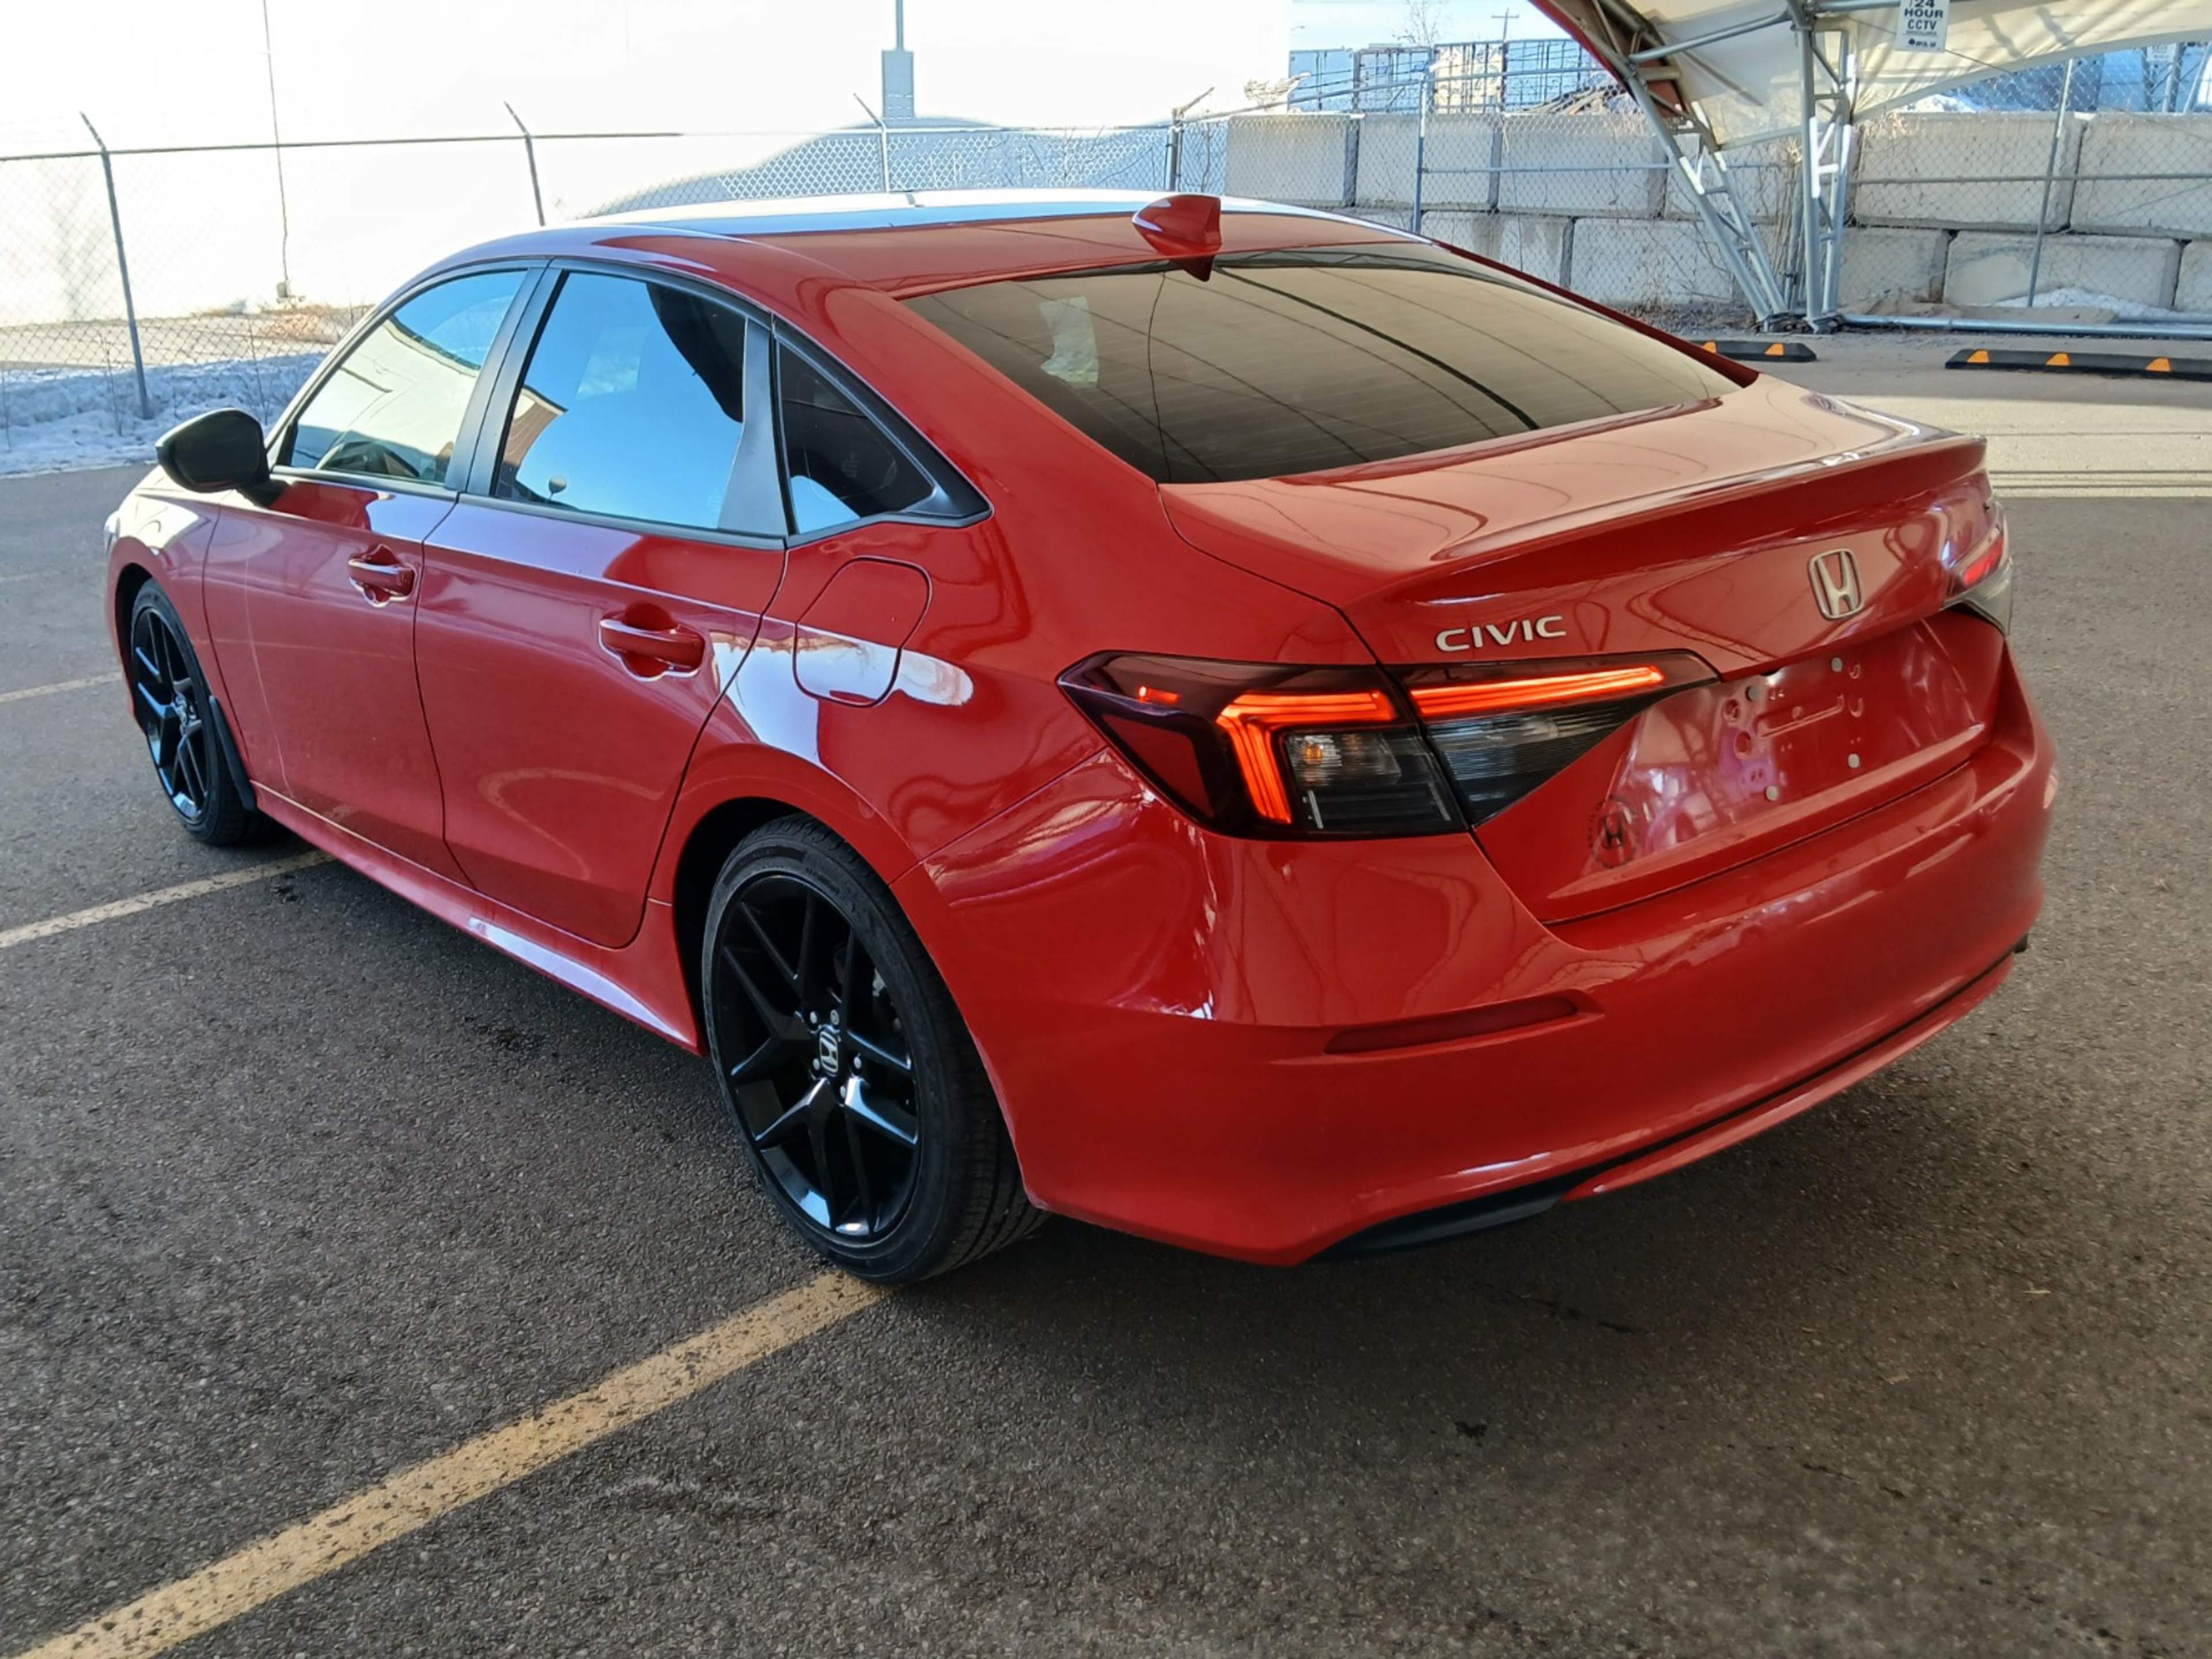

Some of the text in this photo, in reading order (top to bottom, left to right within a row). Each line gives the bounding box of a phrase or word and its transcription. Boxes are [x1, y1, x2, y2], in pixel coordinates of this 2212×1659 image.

[1904, 7, 1944, 18] HOUR
[1908, 19, 1936, 30] CCTV
[1436, 615, 1567, 652] CIVIC
